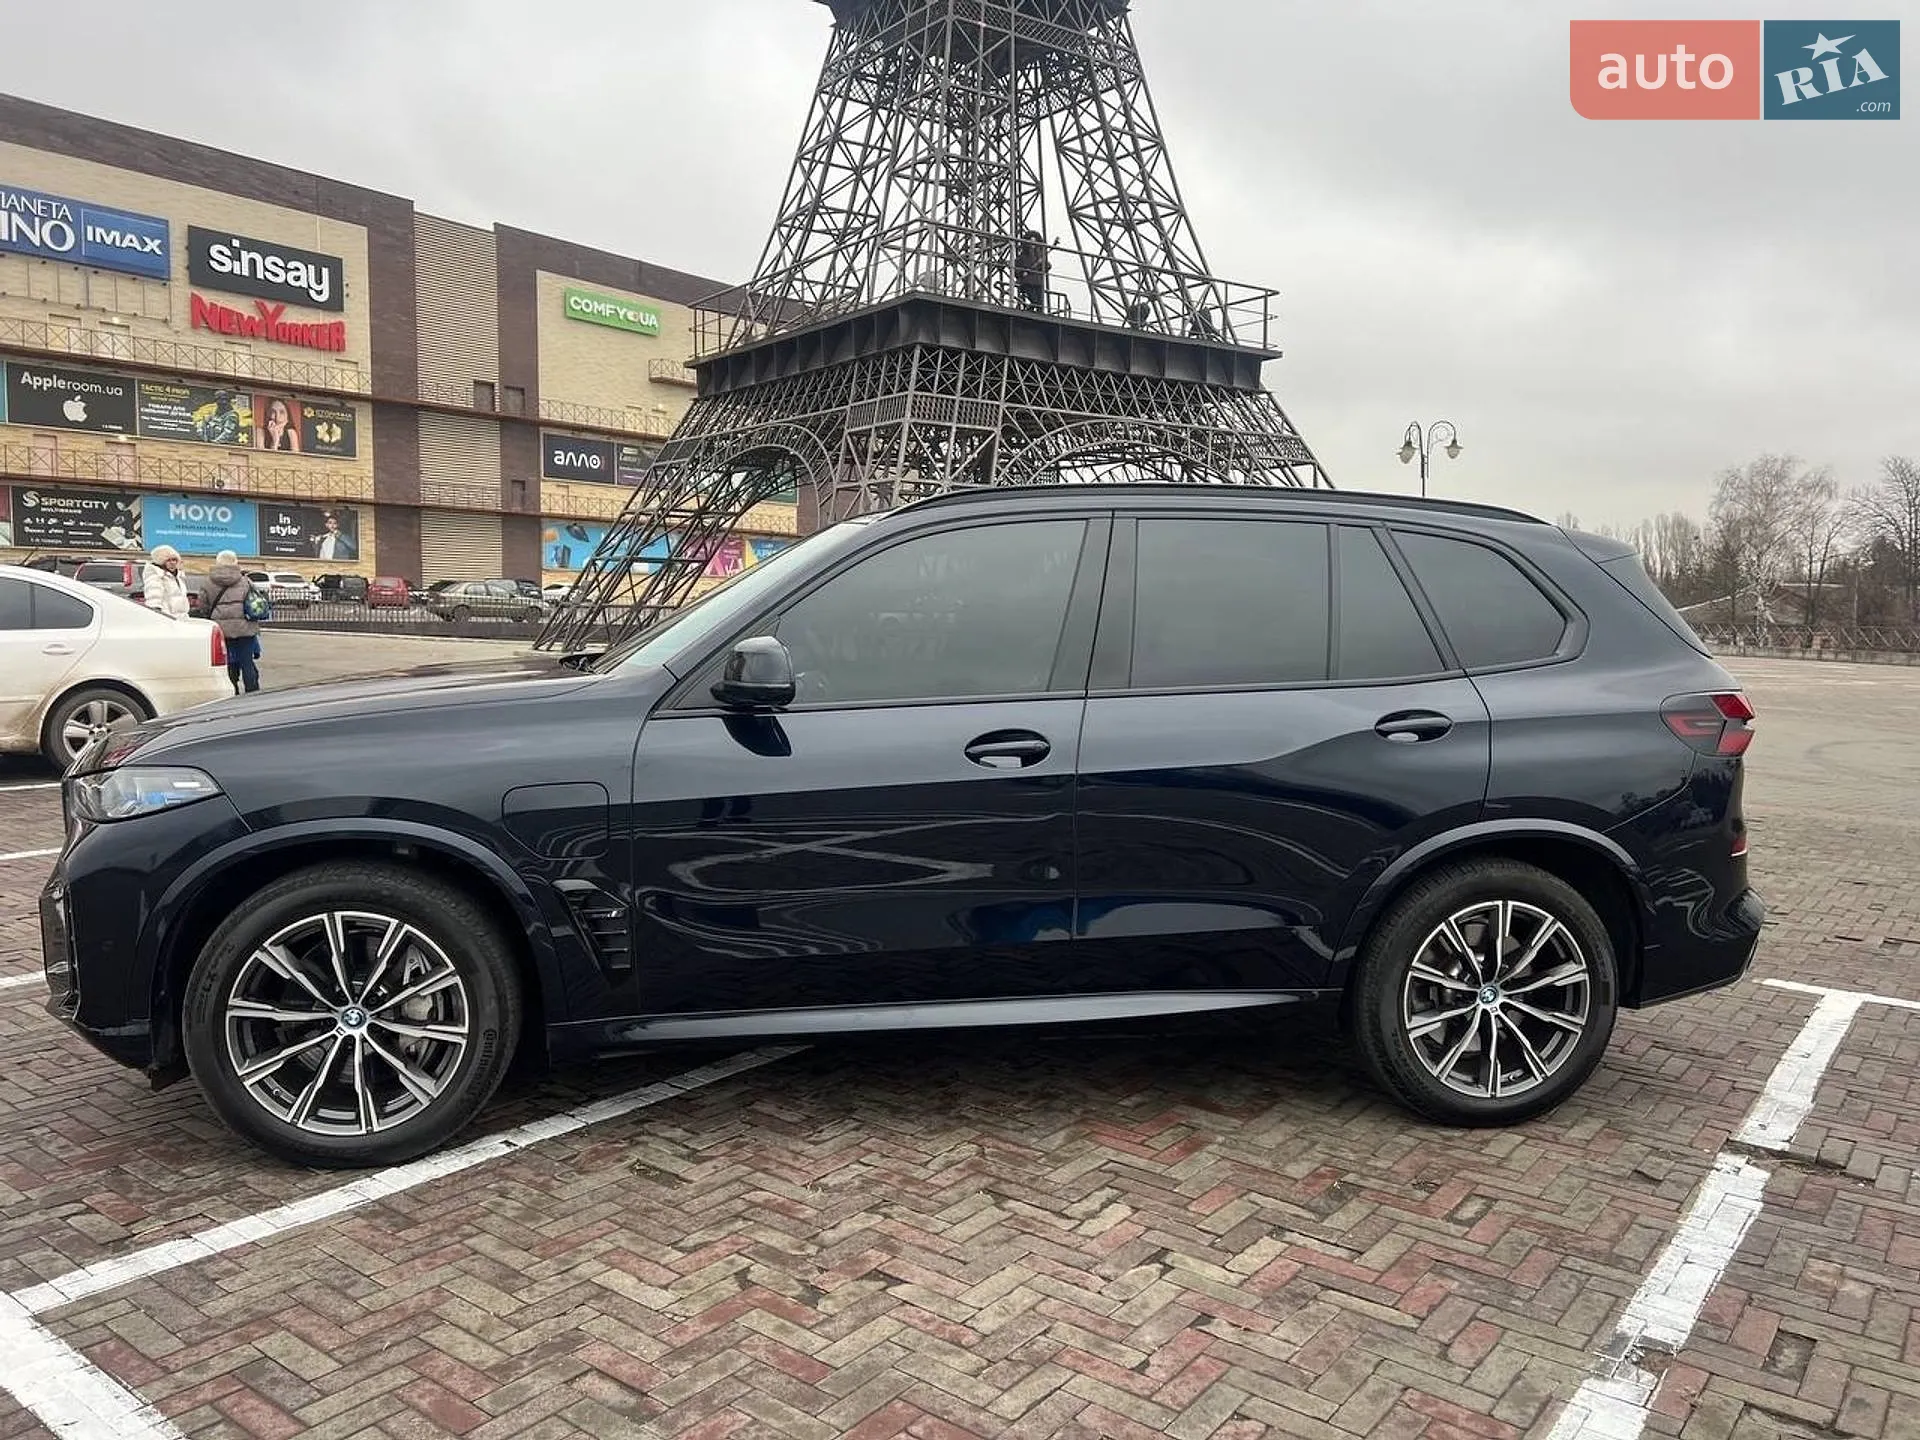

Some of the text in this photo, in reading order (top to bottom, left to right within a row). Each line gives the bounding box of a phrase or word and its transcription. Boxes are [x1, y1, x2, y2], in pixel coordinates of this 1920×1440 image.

[0, 191, 73, 223] LANETA
[0, 210, 75, 252] INO
[86, 225, 163, 255] IMAX
[208, 238, 330, 303] sinsay
[20, 371, 123, 397] Appleroom.ua
[40, 497, 109, 510] SPORTCITY
[169, 503, 232, 523] MOYO
[269, 524, 299, 537] style
[278, 512, 291, 525] in
